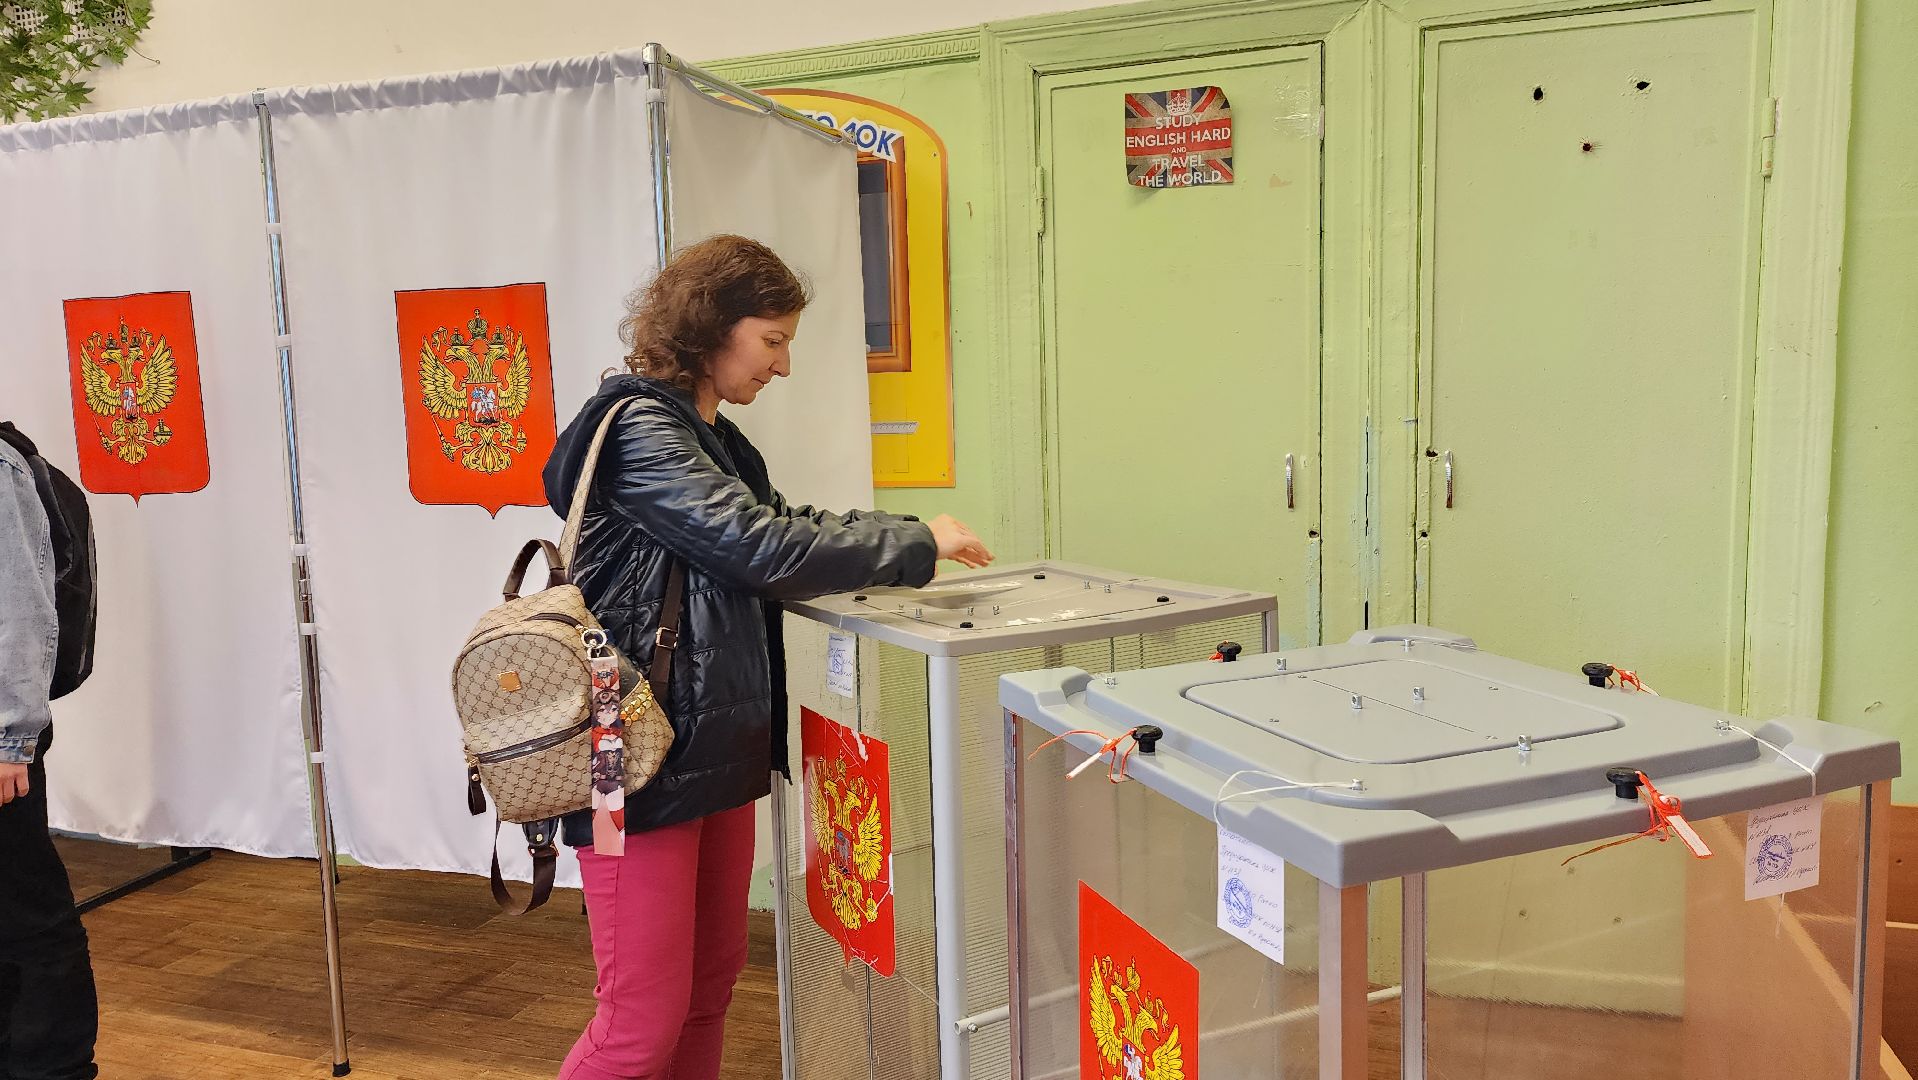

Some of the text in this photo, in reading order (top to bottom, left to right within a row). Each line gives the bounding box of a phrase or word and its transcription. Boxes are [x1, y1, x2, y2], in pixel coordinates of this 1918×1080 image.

[1155, 114, 1202, 130] STUDY
[1126, 127, 1231, 148] ENGLISH HARD
[1171, 146, 1187, 154] AND
[1151, 155, 1206, 171] TRAVEL
[1138, 169, 1222, 187] THE WORLD
